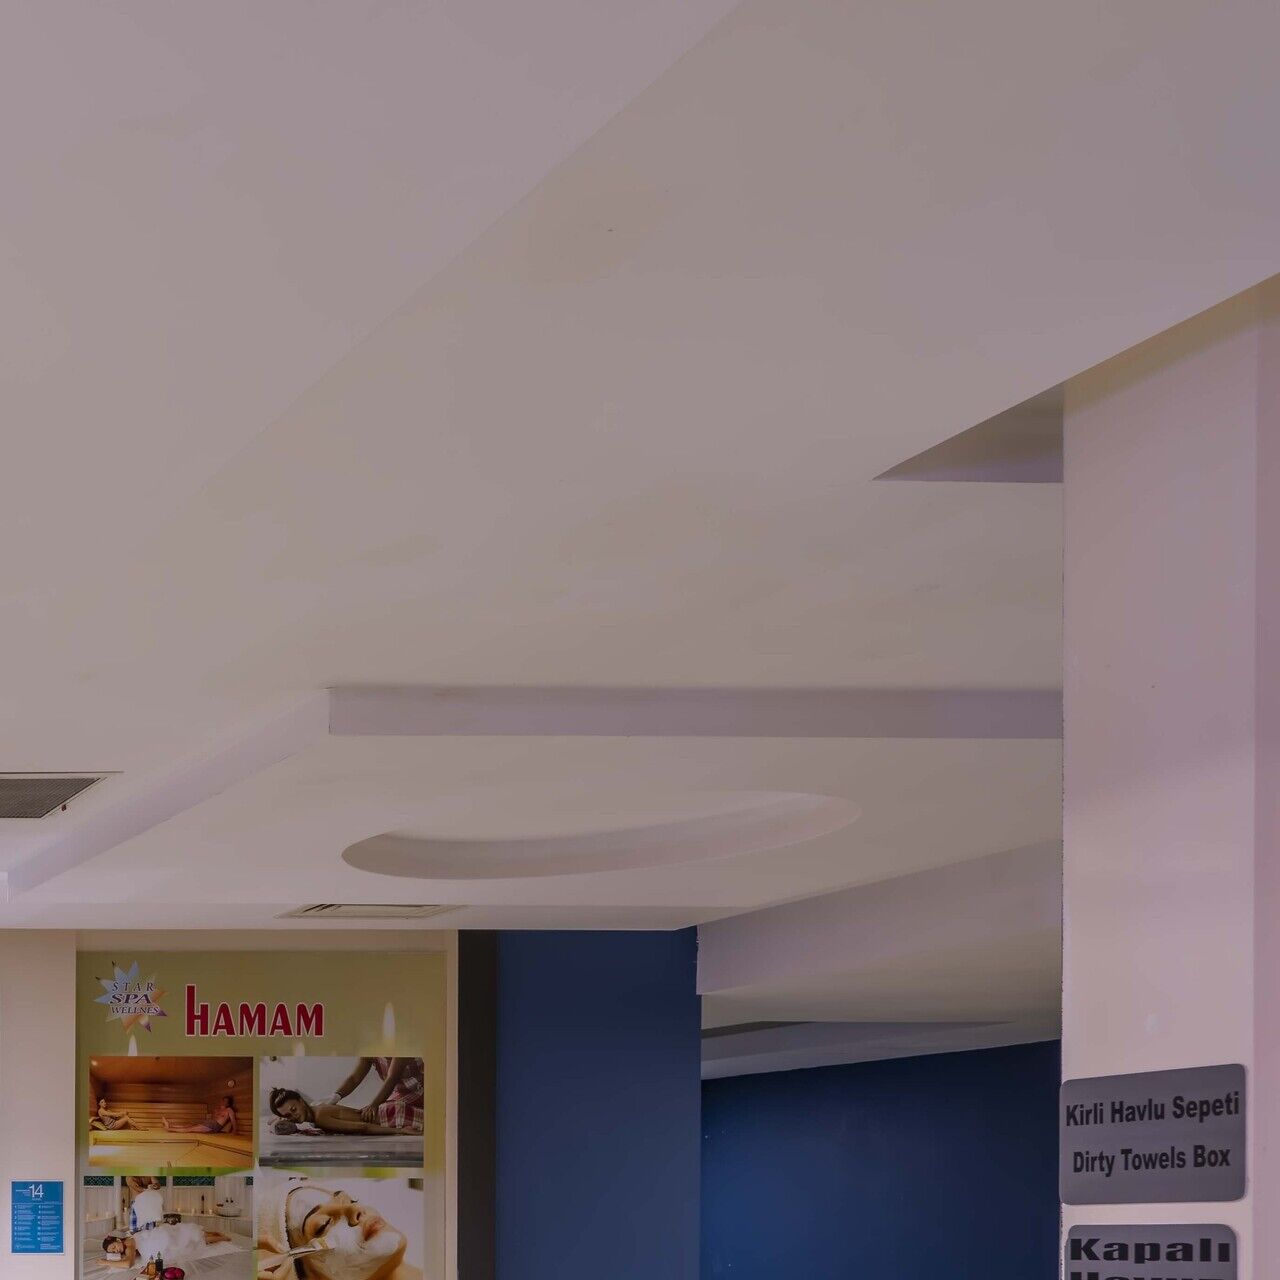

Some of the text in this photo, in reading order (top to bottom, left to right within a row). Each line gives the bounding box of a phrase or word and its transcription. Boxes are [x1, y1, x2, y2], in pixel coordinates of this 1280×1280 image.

[112, 982, 154, 992] STAR
[110, 993, 151, 1004] SPA
[110, 1006, 159, 1014] WELLNES
[185, 984, 324, 1037] HAMAM
[1066, 1091, 1240, 1127] Kirli Havlu Sepeti
[1072, 1144, 1231, 1177] Dirty Towels Box
[28, 1184, 44, 1198] 14
[1070, 1237, 1230, 1264] Kapalı
